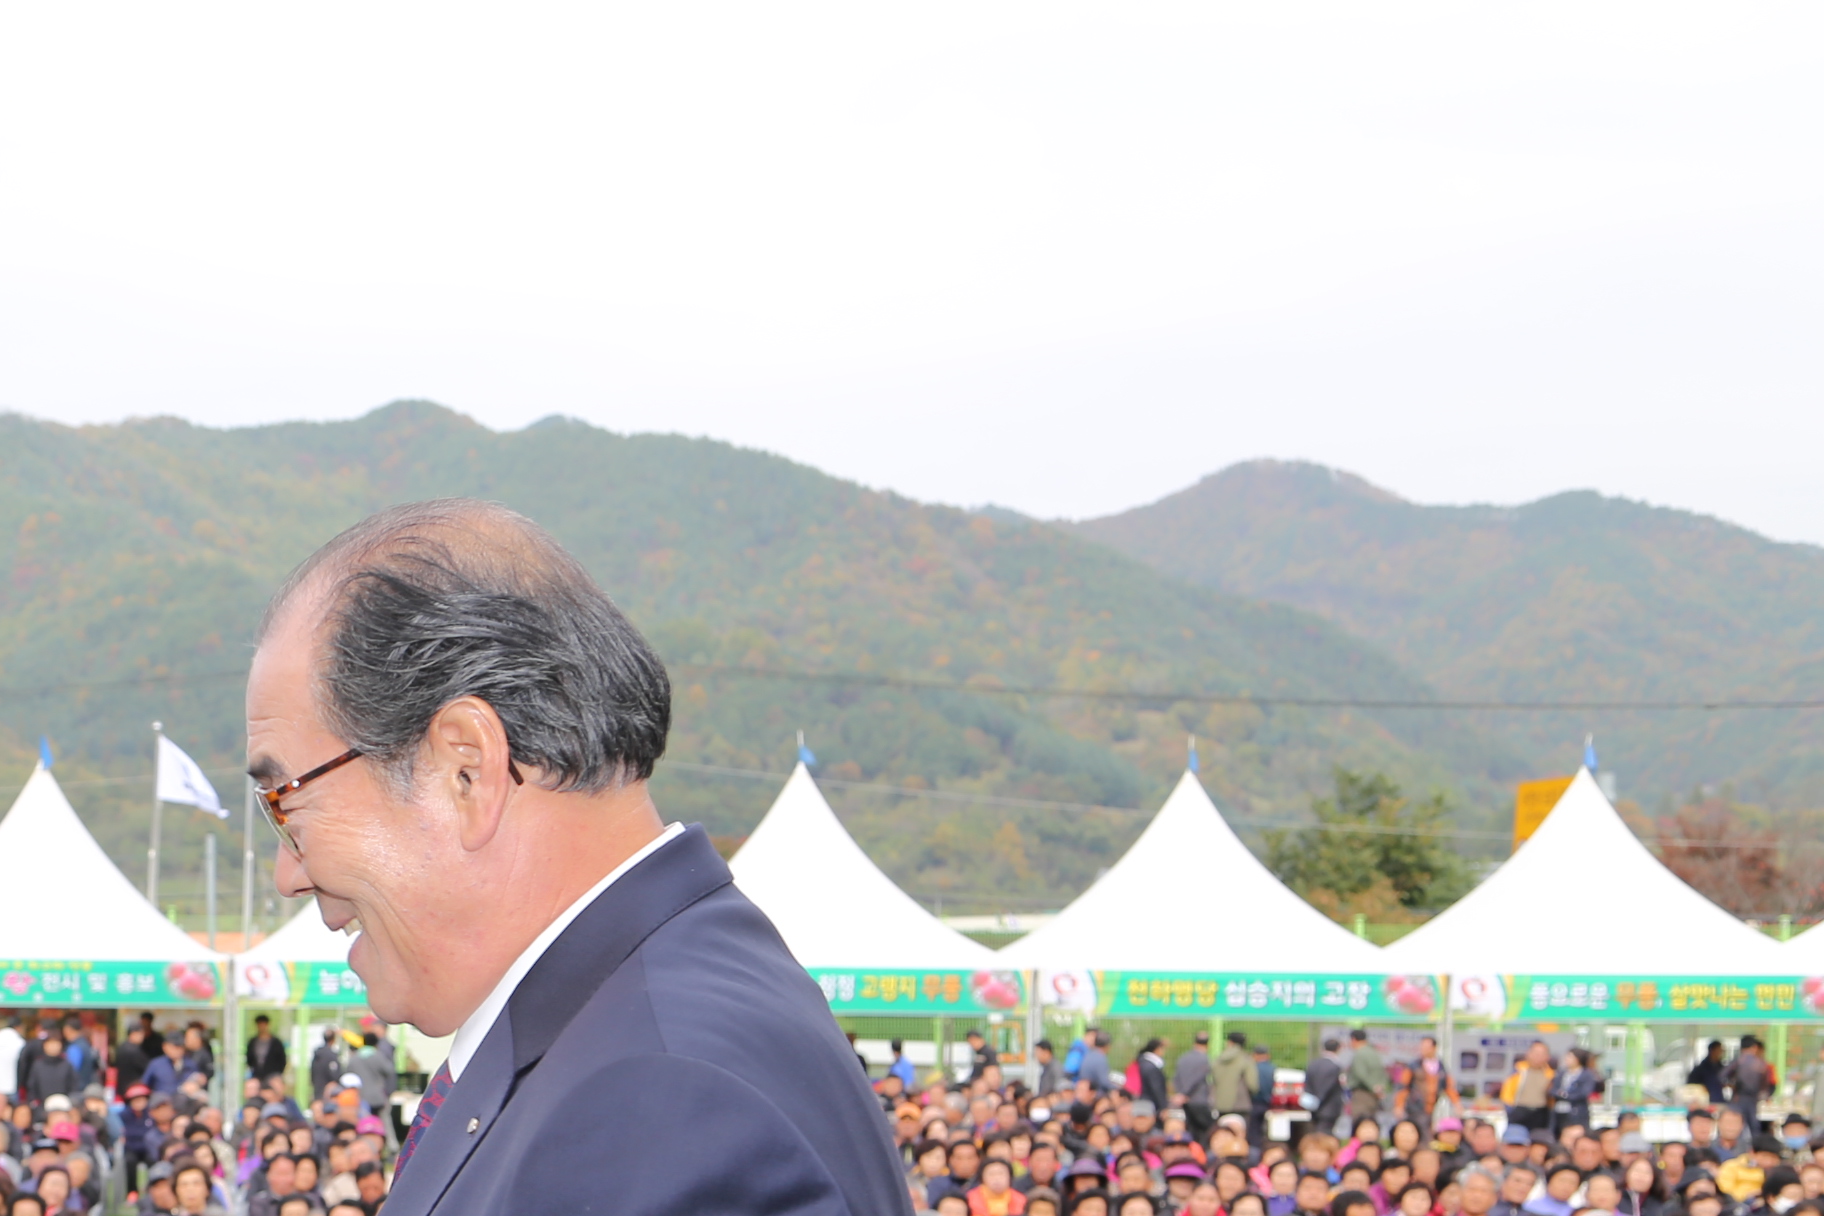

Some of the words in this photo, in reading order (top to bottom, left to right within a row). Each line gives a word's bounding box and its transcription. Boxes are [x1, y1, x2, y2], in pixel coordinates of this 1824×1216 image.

[39, 972, 81, 993] 전시
[86, 972, 108, 993] 및
[114, 973, 157, 994] 홍보
[860, 975, 917, 1003] 고랭지
[921, 974, 963, 1004] 무풍
[1127, 978, 1219, 1008] 천하명당
[1224, 980, 1317, 1009] 십승지의
[1320, 981, 1372, 1011] 고장
[1529, 981, 1610, 1011] 풍요로운
[1669, 983, 1750, 1012] 살맛나는
[1754, 984, 1797, 1012] 면민
